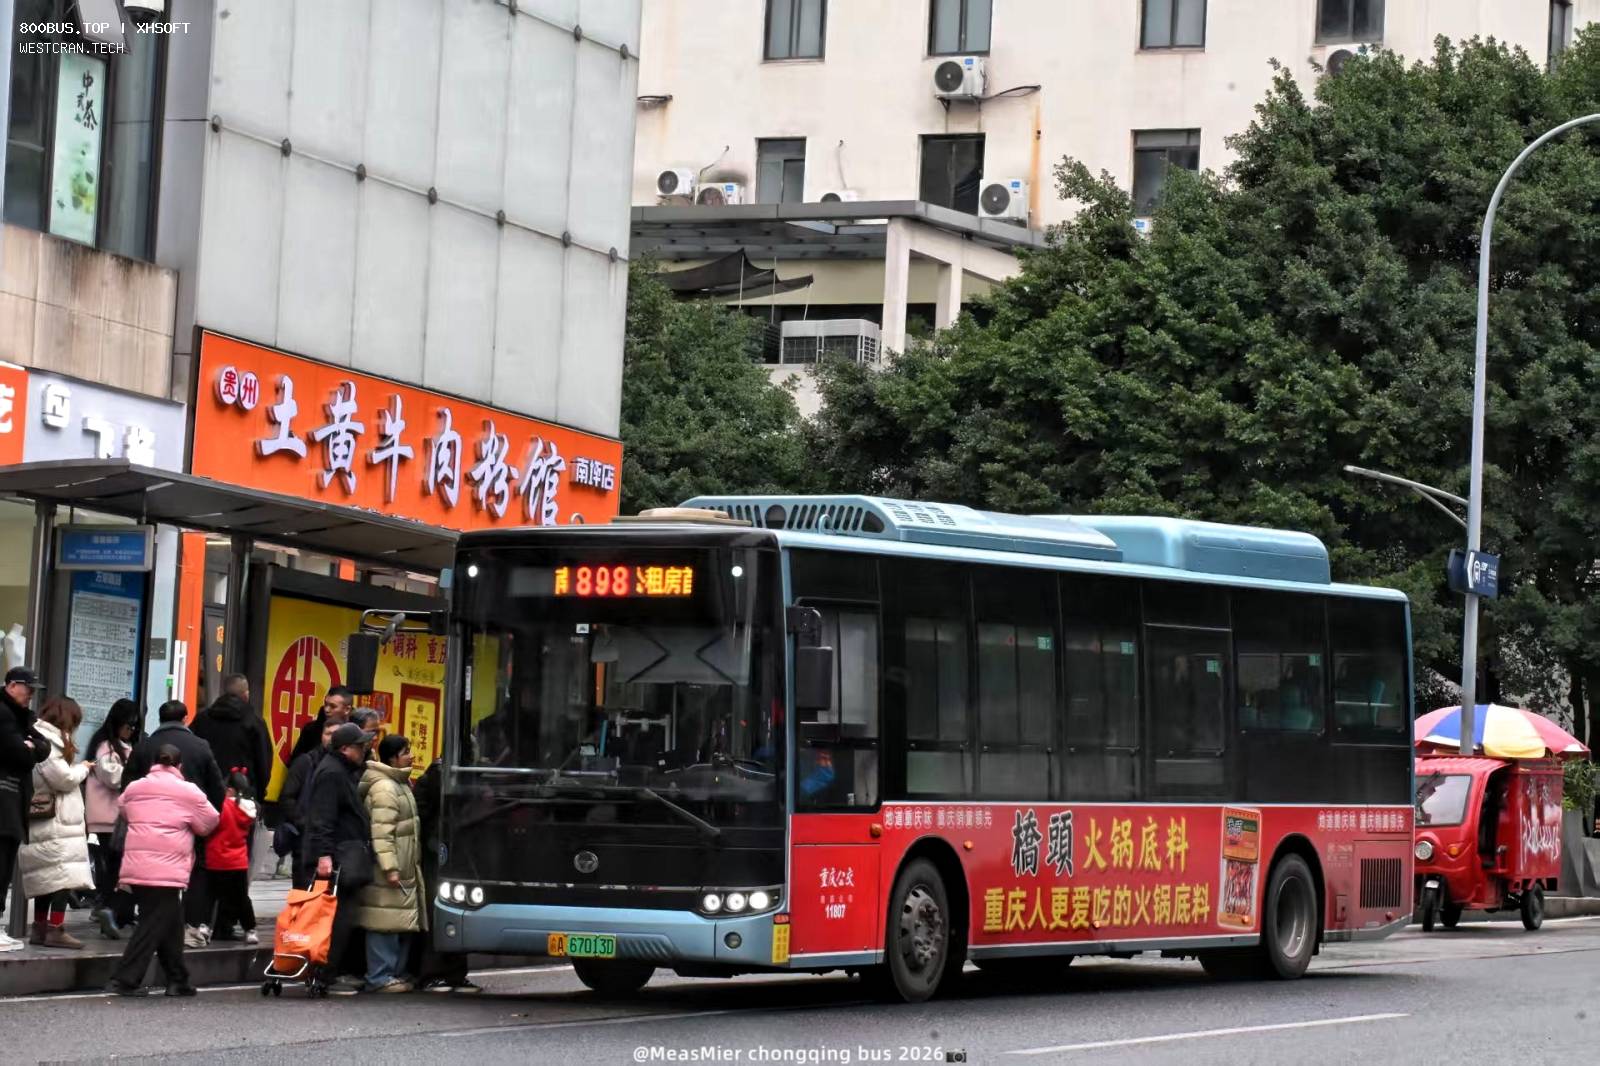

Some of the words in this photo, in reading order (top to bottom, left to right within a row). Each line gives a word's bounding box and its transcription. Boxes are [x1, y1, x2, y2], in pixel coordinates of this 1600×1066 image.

[219, 367, 259, 410] 贵州
[256, 375, 566, 526] 土黄牛肉粉馆
[575, 456, 615, 490] 南坪店
[576, 566, 628, 595] 898
[1011, 809, 1073, 878] 橋頭
[1083, 816, 1188, 872] 火锅底料
[819, 867, 854, 888] 重庆公交
[825, 904, 846, 919] 11807
[983, 883, 1210, 931] 重庆人更爱吃的火锅底料
[570, 937, 614, 954] 67013D
